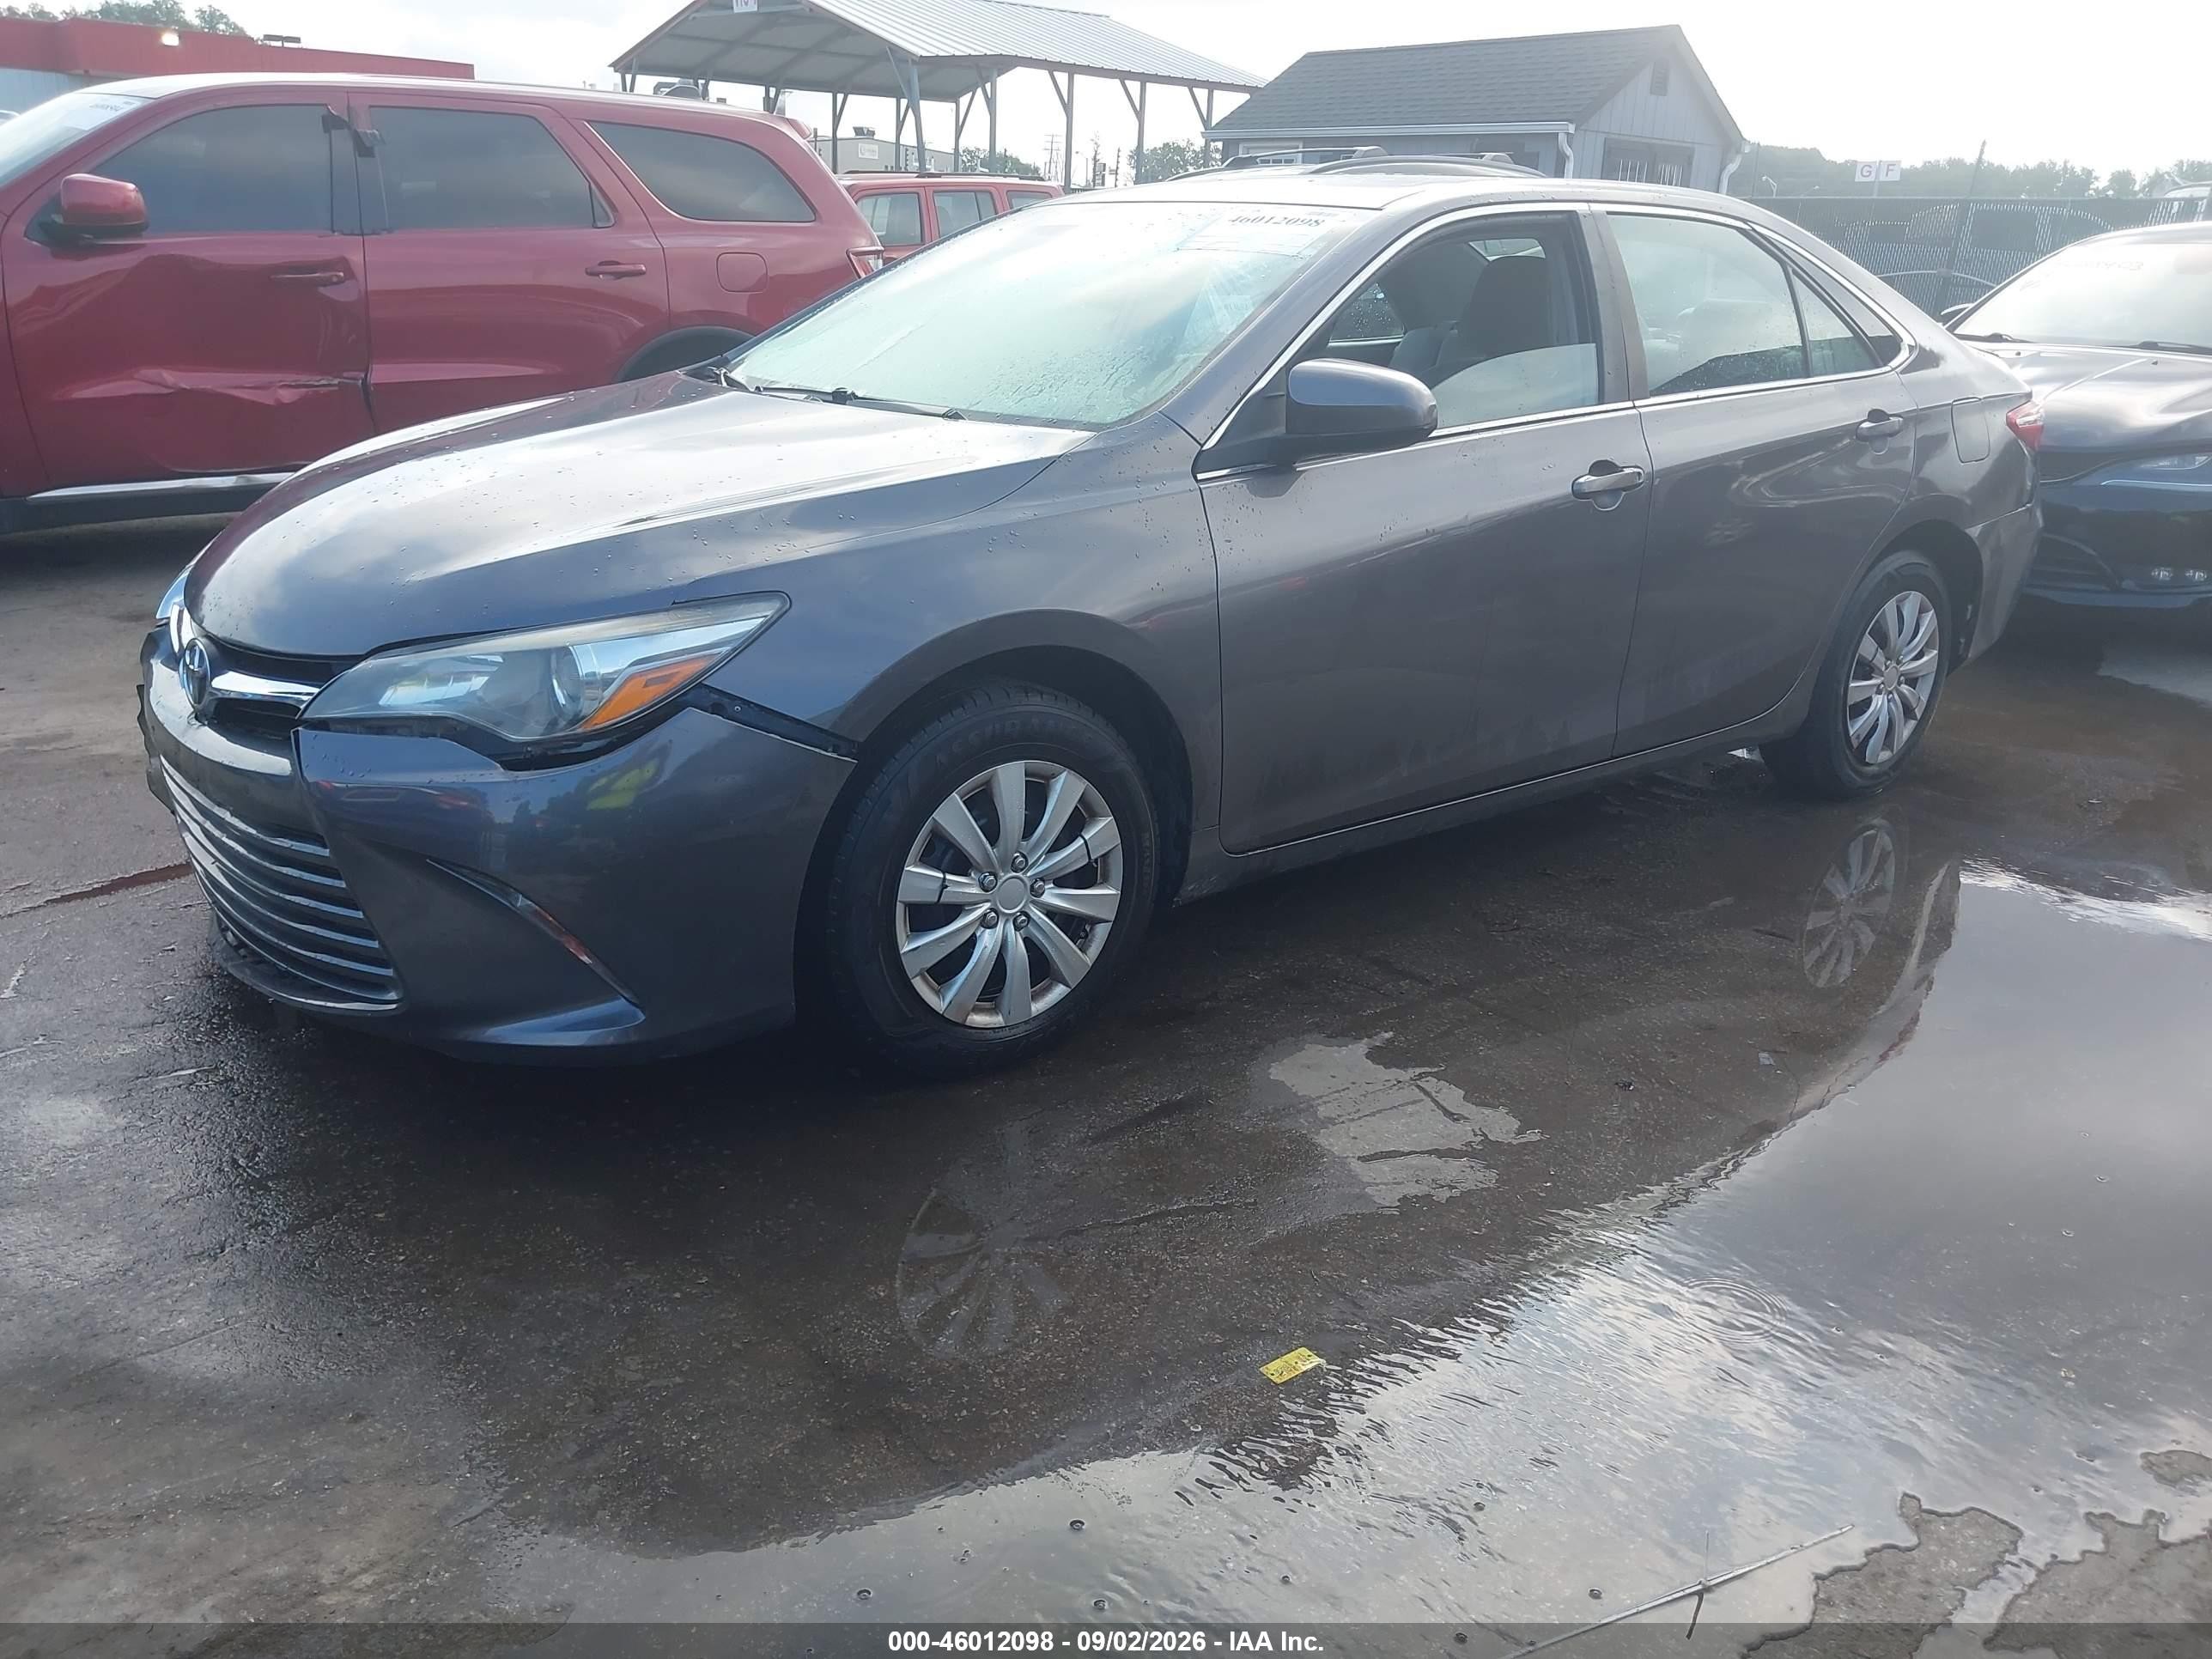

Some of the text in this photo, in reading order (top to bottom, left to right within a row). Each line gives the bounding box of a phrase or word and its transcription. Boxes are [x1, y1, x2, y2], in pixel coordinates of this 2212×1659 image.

[1860, 164, 1873, 178] G
[1886, 163, 1897, 178] F
[1229, 215, 1325, 227] 46012098
